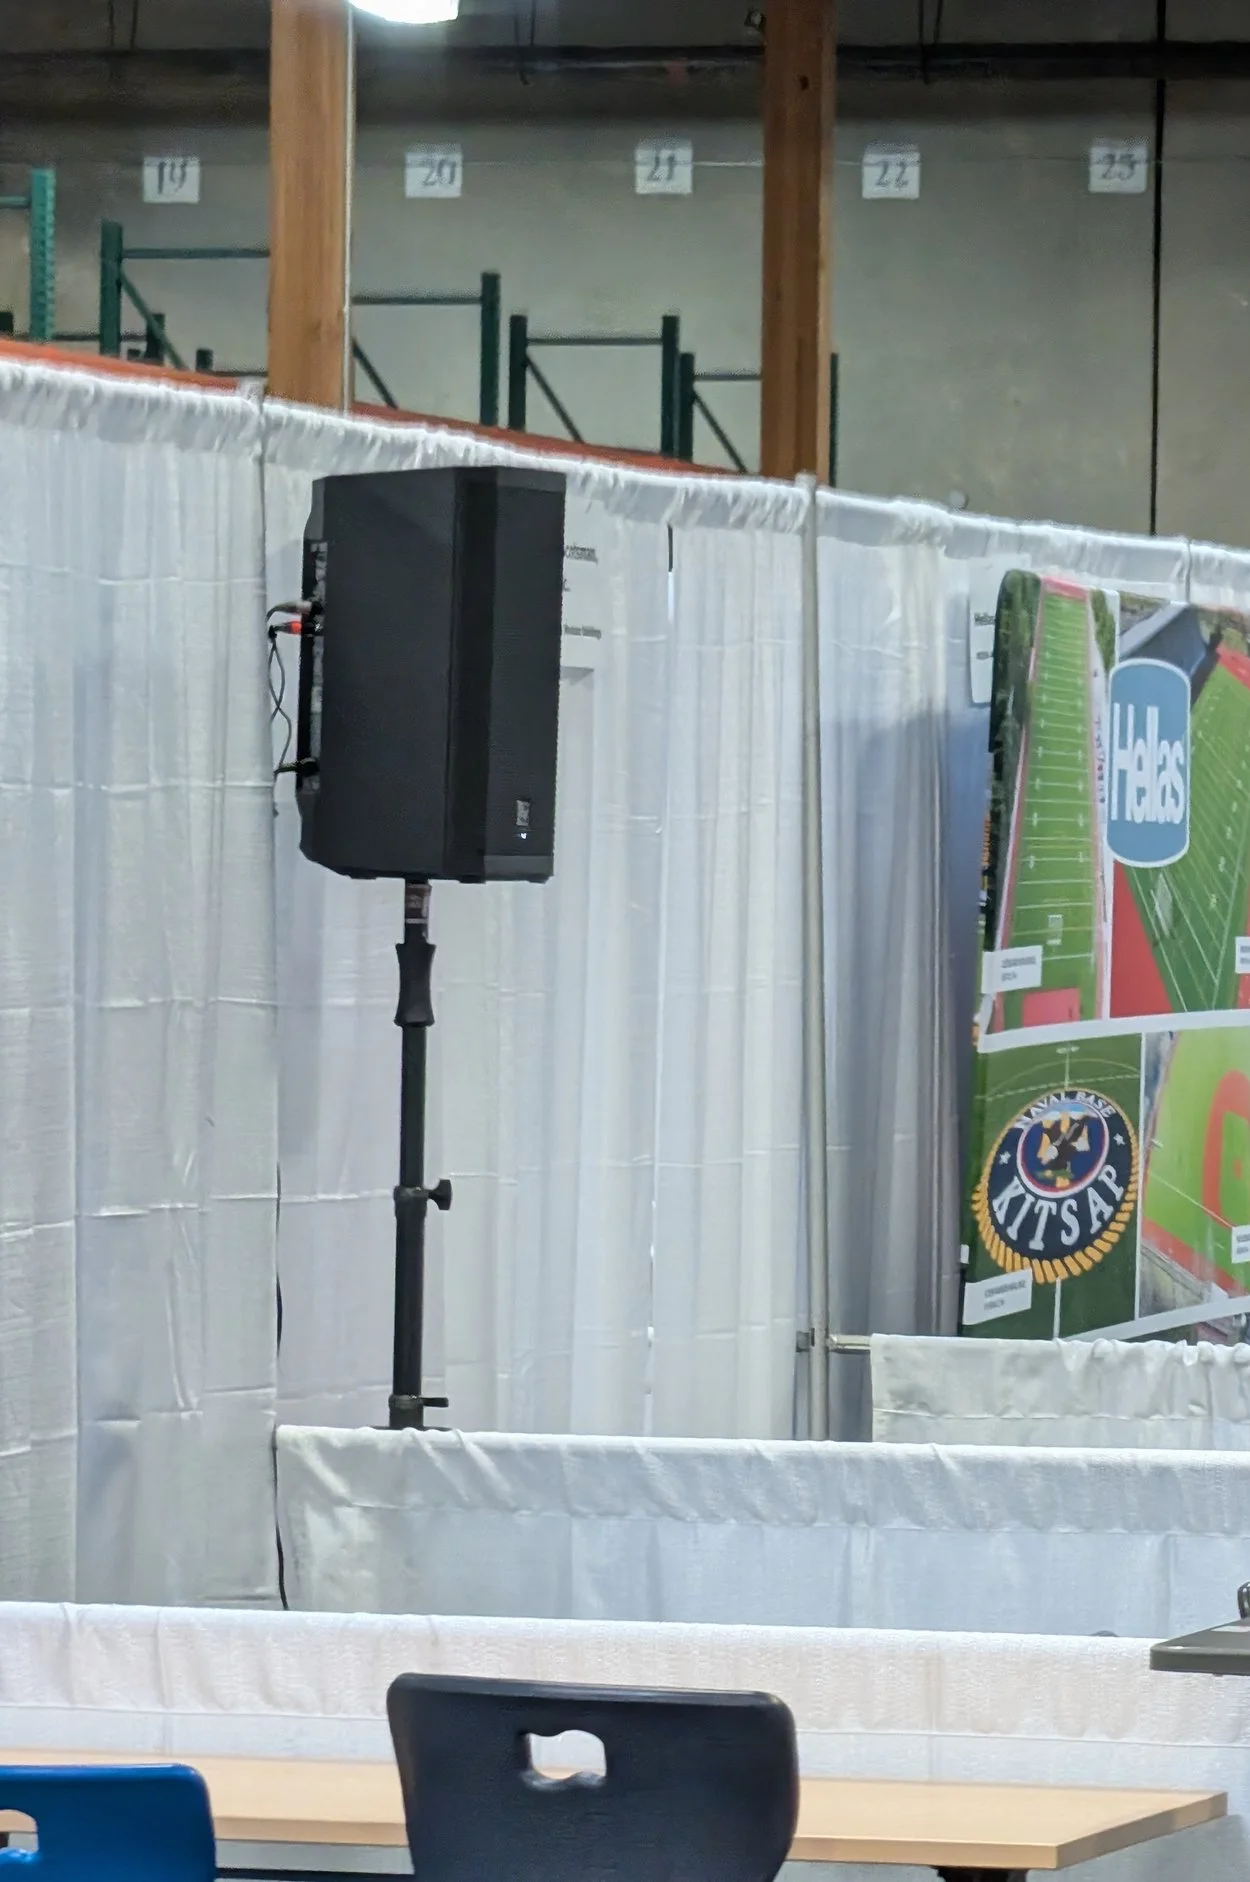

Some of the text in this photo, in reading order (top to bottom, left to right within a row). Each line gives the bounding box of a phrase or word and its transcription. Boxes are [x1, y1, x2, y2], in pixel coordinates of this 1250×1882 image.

[156, 159, 189, 196] 19
[421, 157, 456, 187] 20
[646, 153, 676, 183] 21
[875, 158, 909, 189] 22
[1111, 702, 1185, 824] Hellas
[1076, 1091, 1118, 1119] BASE
[992, 1164, 1125, 1251] KITSAP
